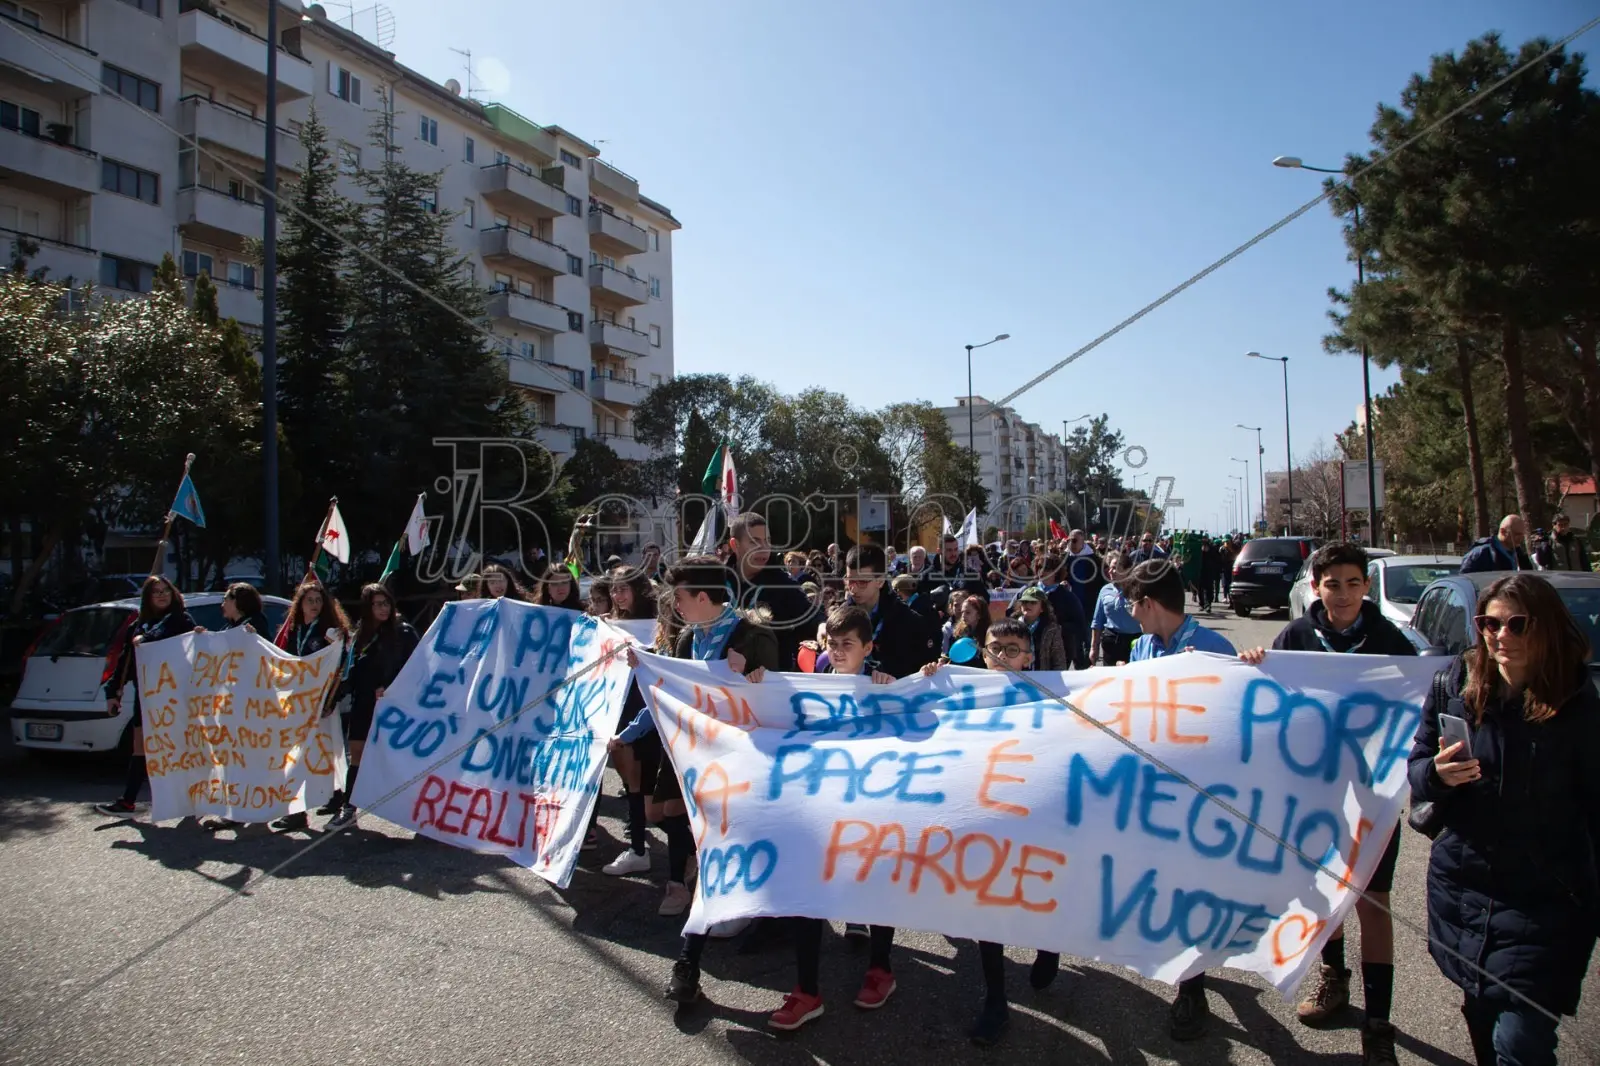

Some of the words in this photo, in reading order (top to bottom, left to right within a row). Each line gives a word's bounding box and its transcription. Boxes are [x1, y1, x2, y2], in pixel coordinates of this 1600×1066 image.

[437, 602, 499, 656] LA
[143, 661, 178, 697] LA
[477, 674, 530, 725] UN
[763, 743, 964, 804] PACE
[1100, 853, 1279, 952] VUOTE
